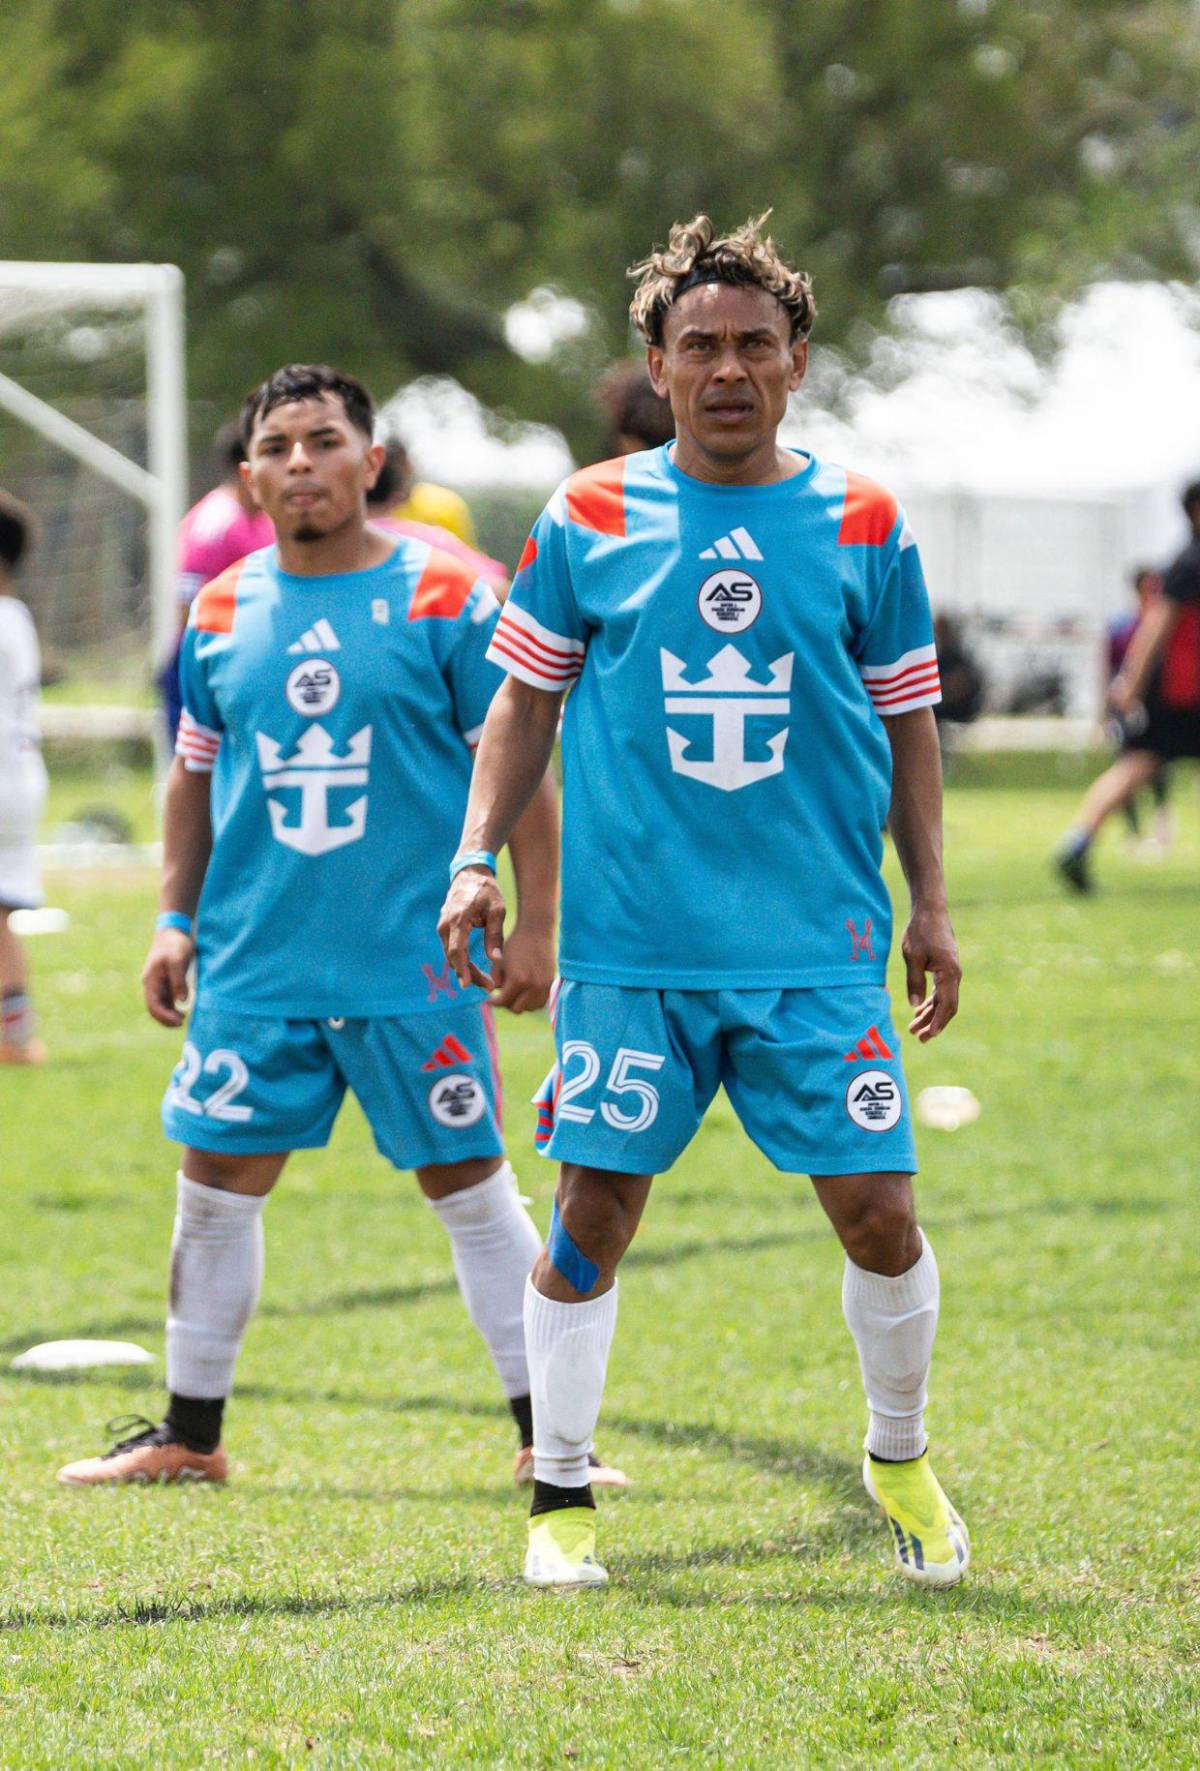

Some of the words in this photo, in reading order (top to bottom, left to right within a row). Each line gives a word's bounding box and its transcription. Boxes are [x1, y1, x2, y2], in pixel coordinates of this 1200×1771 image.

[705, 582, 753, 601] AS
[294, 668, 332, 688] AS
[164, 1041, 254, 1121] 22
[559, 1040, 665, 1132] 25
[437, 1081, 475, 1104] AS
[853, 1082, 894, 1102] AS
